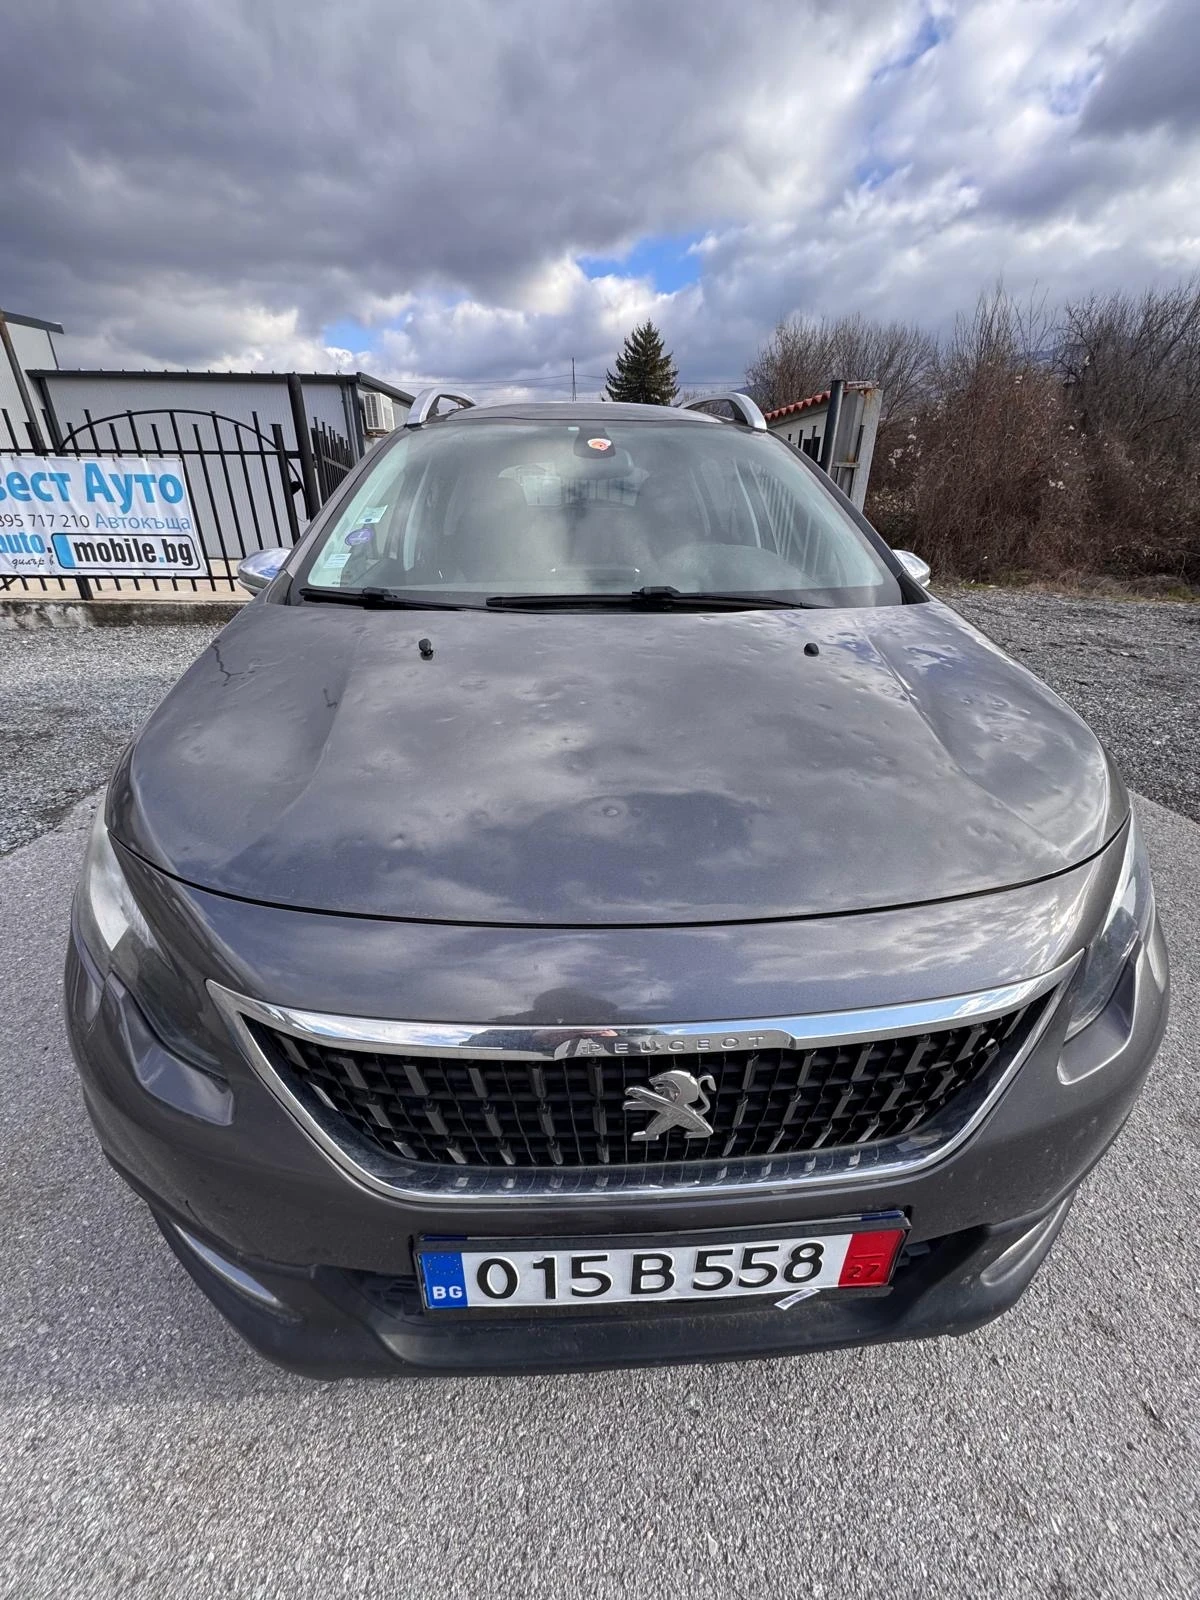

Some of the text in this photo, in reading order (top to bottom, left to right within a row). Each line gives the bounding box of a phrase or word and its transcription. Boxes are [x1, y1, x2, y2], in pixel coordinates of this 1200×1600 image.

[84, 462, 184, 514] Ауто
[28, 514, 55, 528] 717
[61, 514, 90, 528] 210
[95, 512, 191, 531] Автокъща
[73, 538, 194, 567] mobile.bg
[582, 1036, 764, 1054] PEUGEOT
[848, 1263, 880, 1278] 27
[433, 1286, 463, 1299] BG
